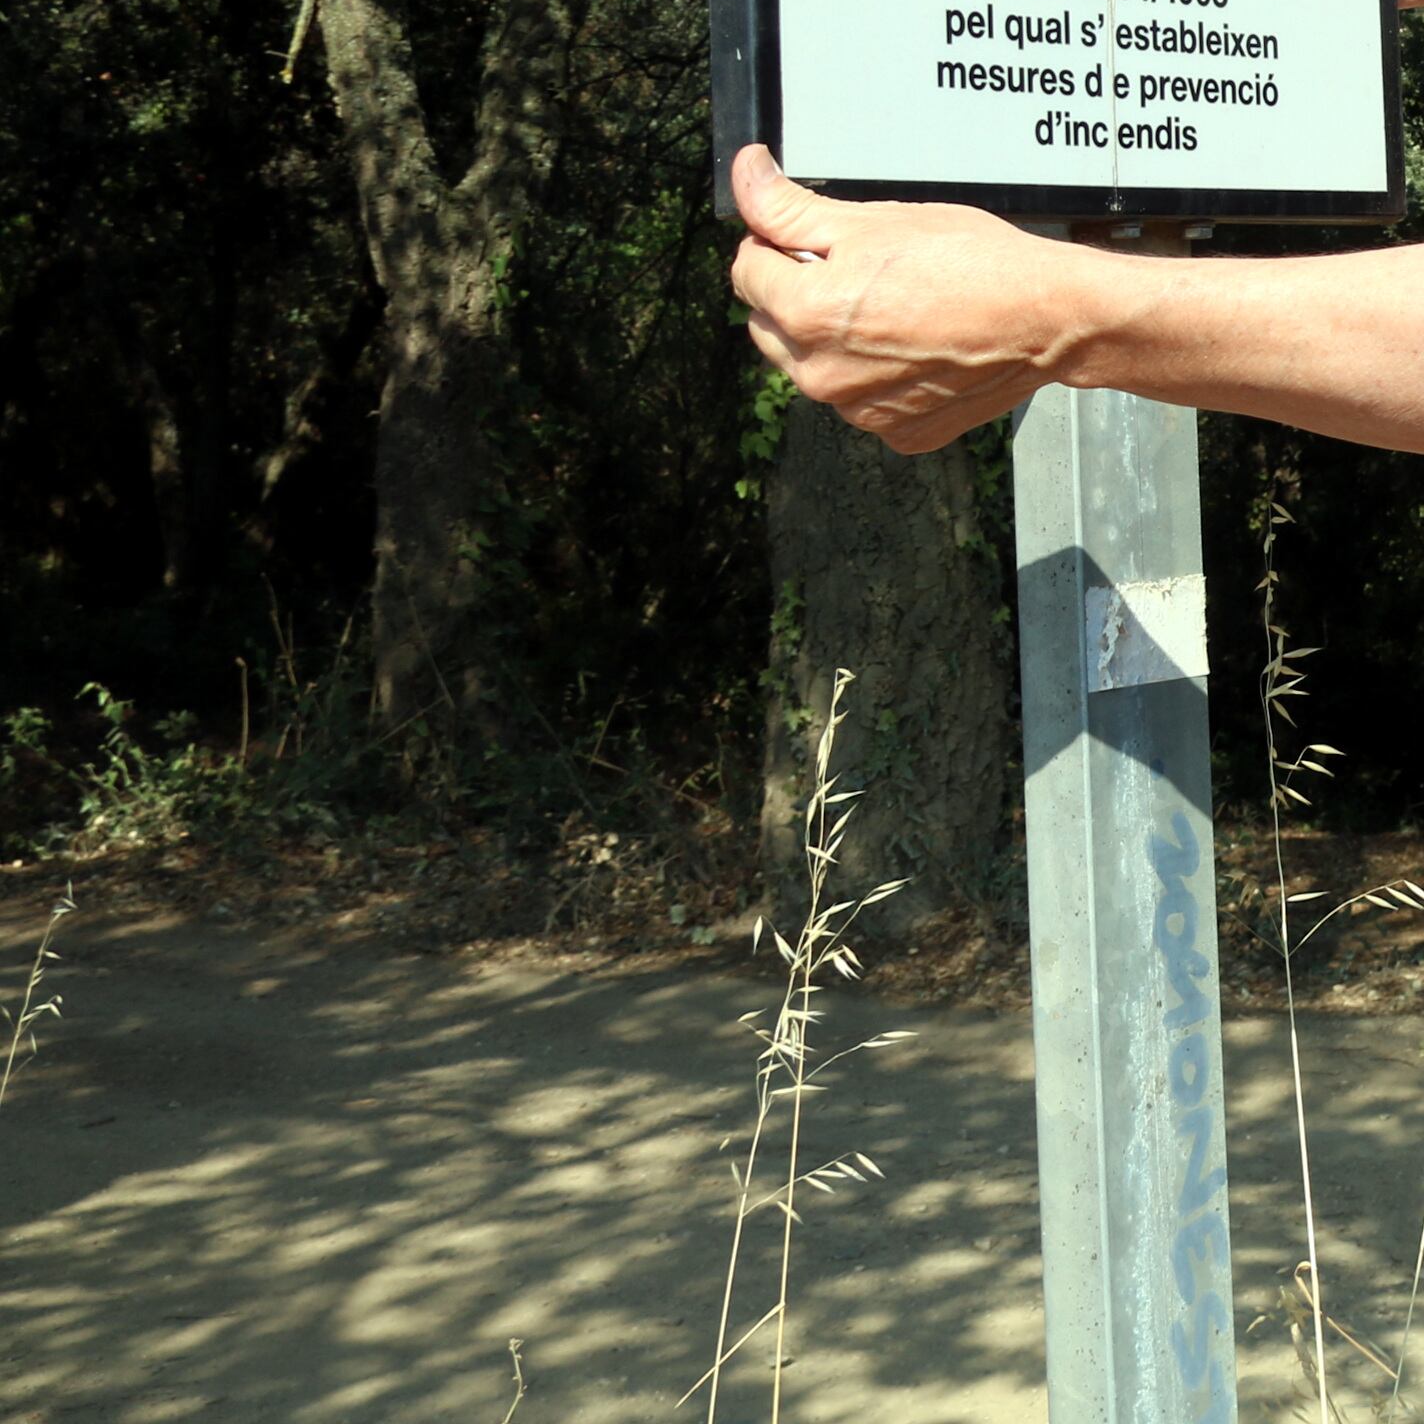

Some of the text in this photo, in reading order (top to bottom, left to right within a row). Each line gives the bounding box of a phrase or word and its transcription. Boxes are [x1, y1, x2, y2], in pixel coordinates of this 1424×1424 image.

[945, 3, 994, 45] pel
[1004, 10, 1071, 50] qual
[937, 61, 1279, 108] mesures de prevenció
